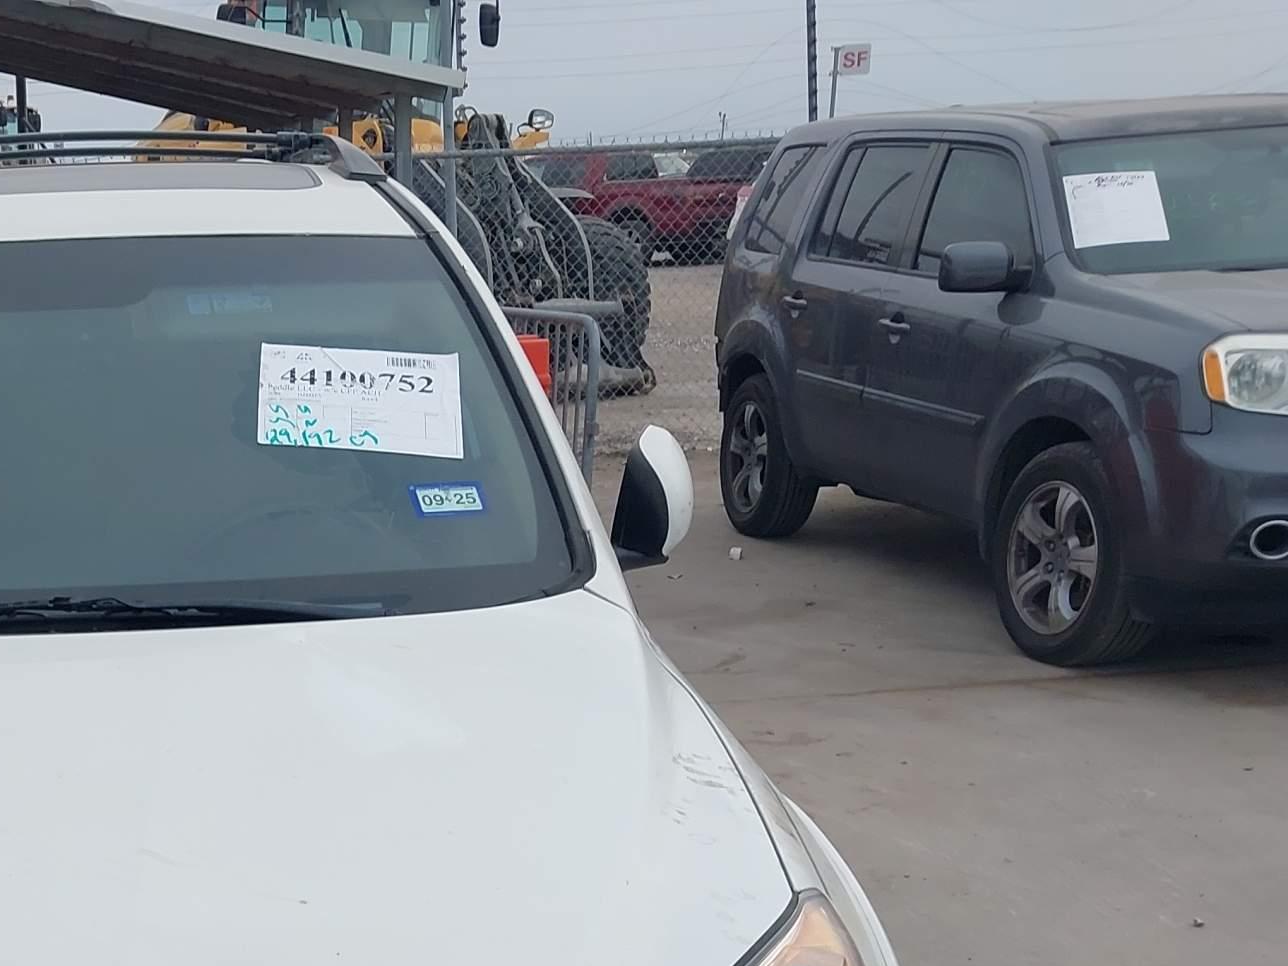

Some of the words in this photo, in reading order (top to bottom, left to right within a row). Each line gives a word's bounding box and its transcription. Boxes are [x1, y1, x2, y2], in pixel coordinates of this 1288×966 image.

[842, 50, 869, 69] SF
[280, 366, 434, 394] 44100752
[421, 494, 445, 507] 09
[453, 492, 477, 505] 25
